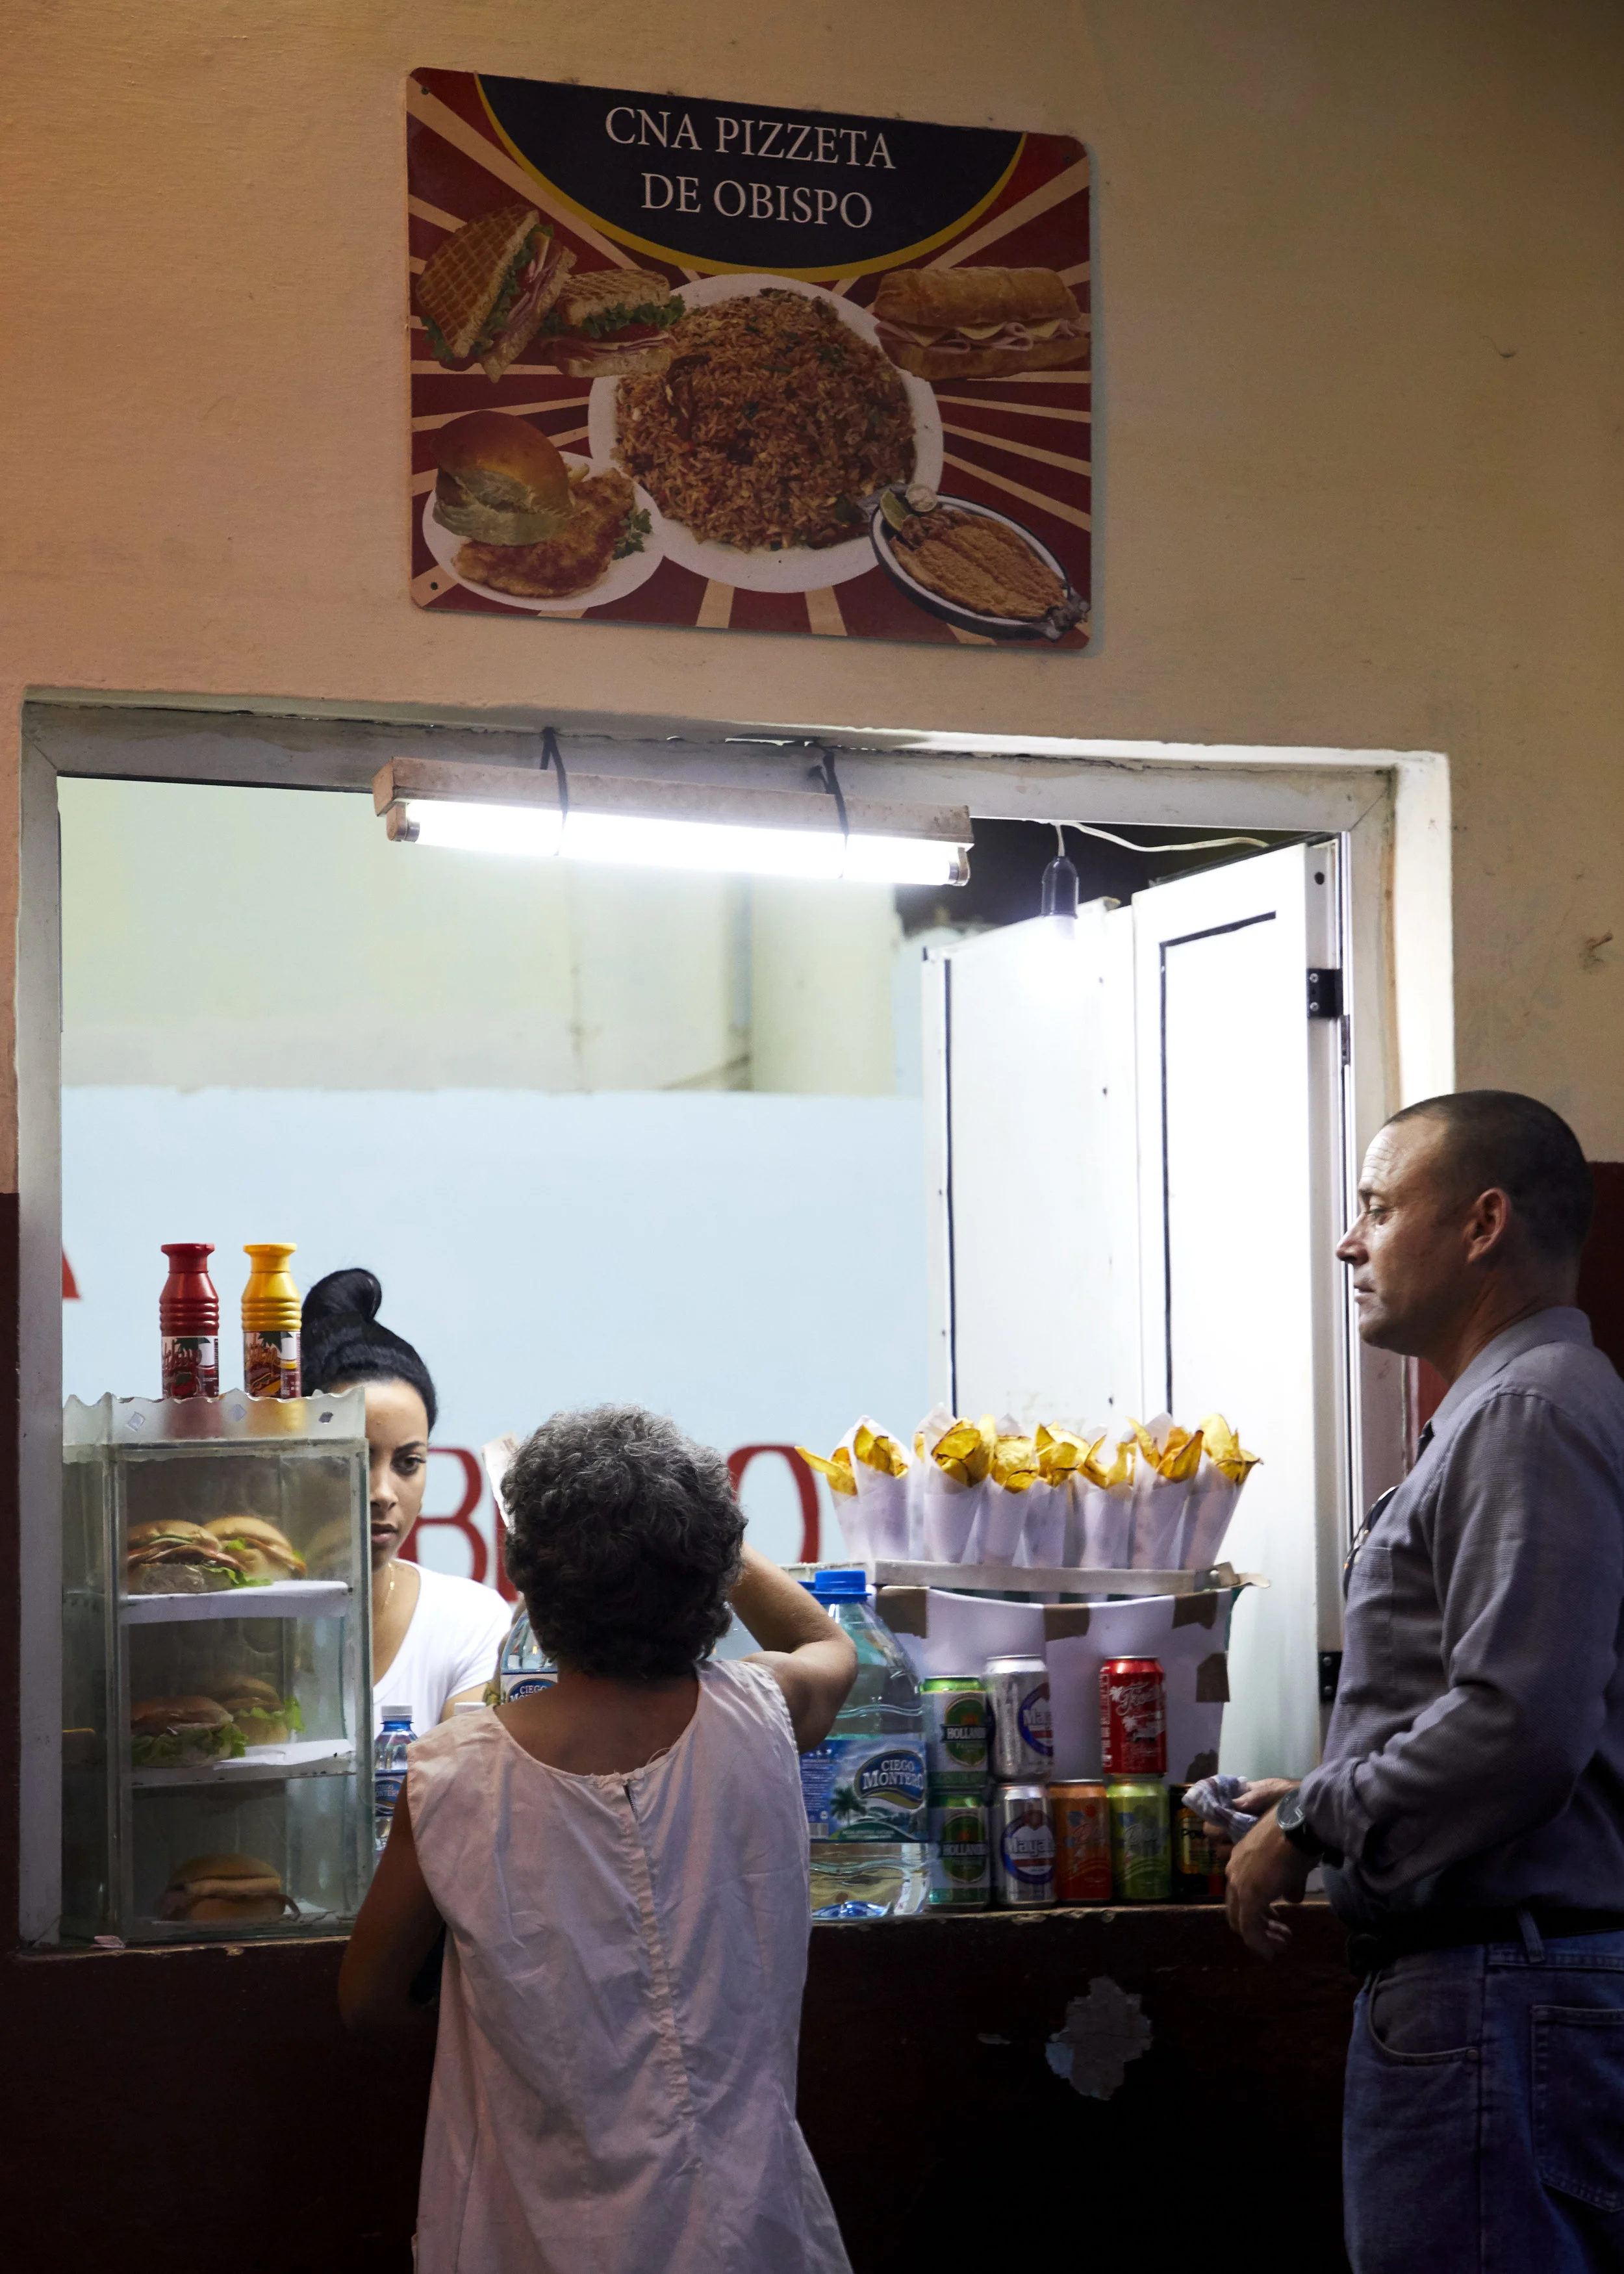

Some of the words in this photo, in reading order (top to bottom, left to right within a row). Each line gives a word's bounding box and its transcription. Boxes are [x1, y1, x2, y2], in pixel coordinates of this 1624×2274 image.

[605, 107, 702, 151] CNA
[715, 116, 896, 170] PIZZETA
[641, 172, 702, 214] DE
[713, 179, 872, 229] OBISPO
[881, 1759, 915, 1772] CIEGO
